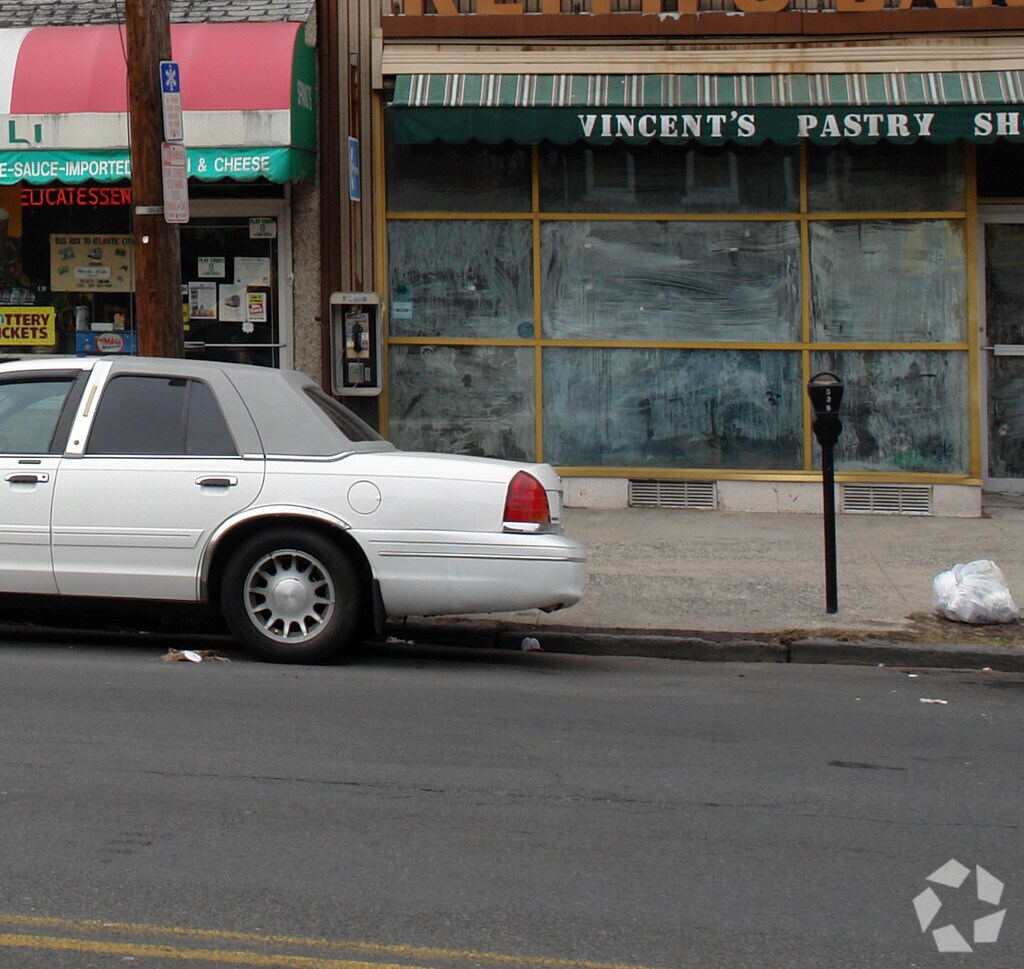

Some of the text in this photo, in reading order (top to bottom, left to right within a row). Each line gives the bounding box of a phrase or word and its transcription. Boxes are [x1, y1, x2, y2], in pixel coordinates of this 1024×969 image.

[578, 110, 1024, 138] VINCENT'S PASTRY SH
[197, 157, 207, 172] &
[214, 155, 270, 172] CHEESE
[21, 187, 132, 207] ELICATESSEN
[55, 237, 67, 245] BUS
[69, 237, 81, 245] RIDE
[84, 237, 91, 245] TO
[93, 237, 119, 245] ATLANTIC
